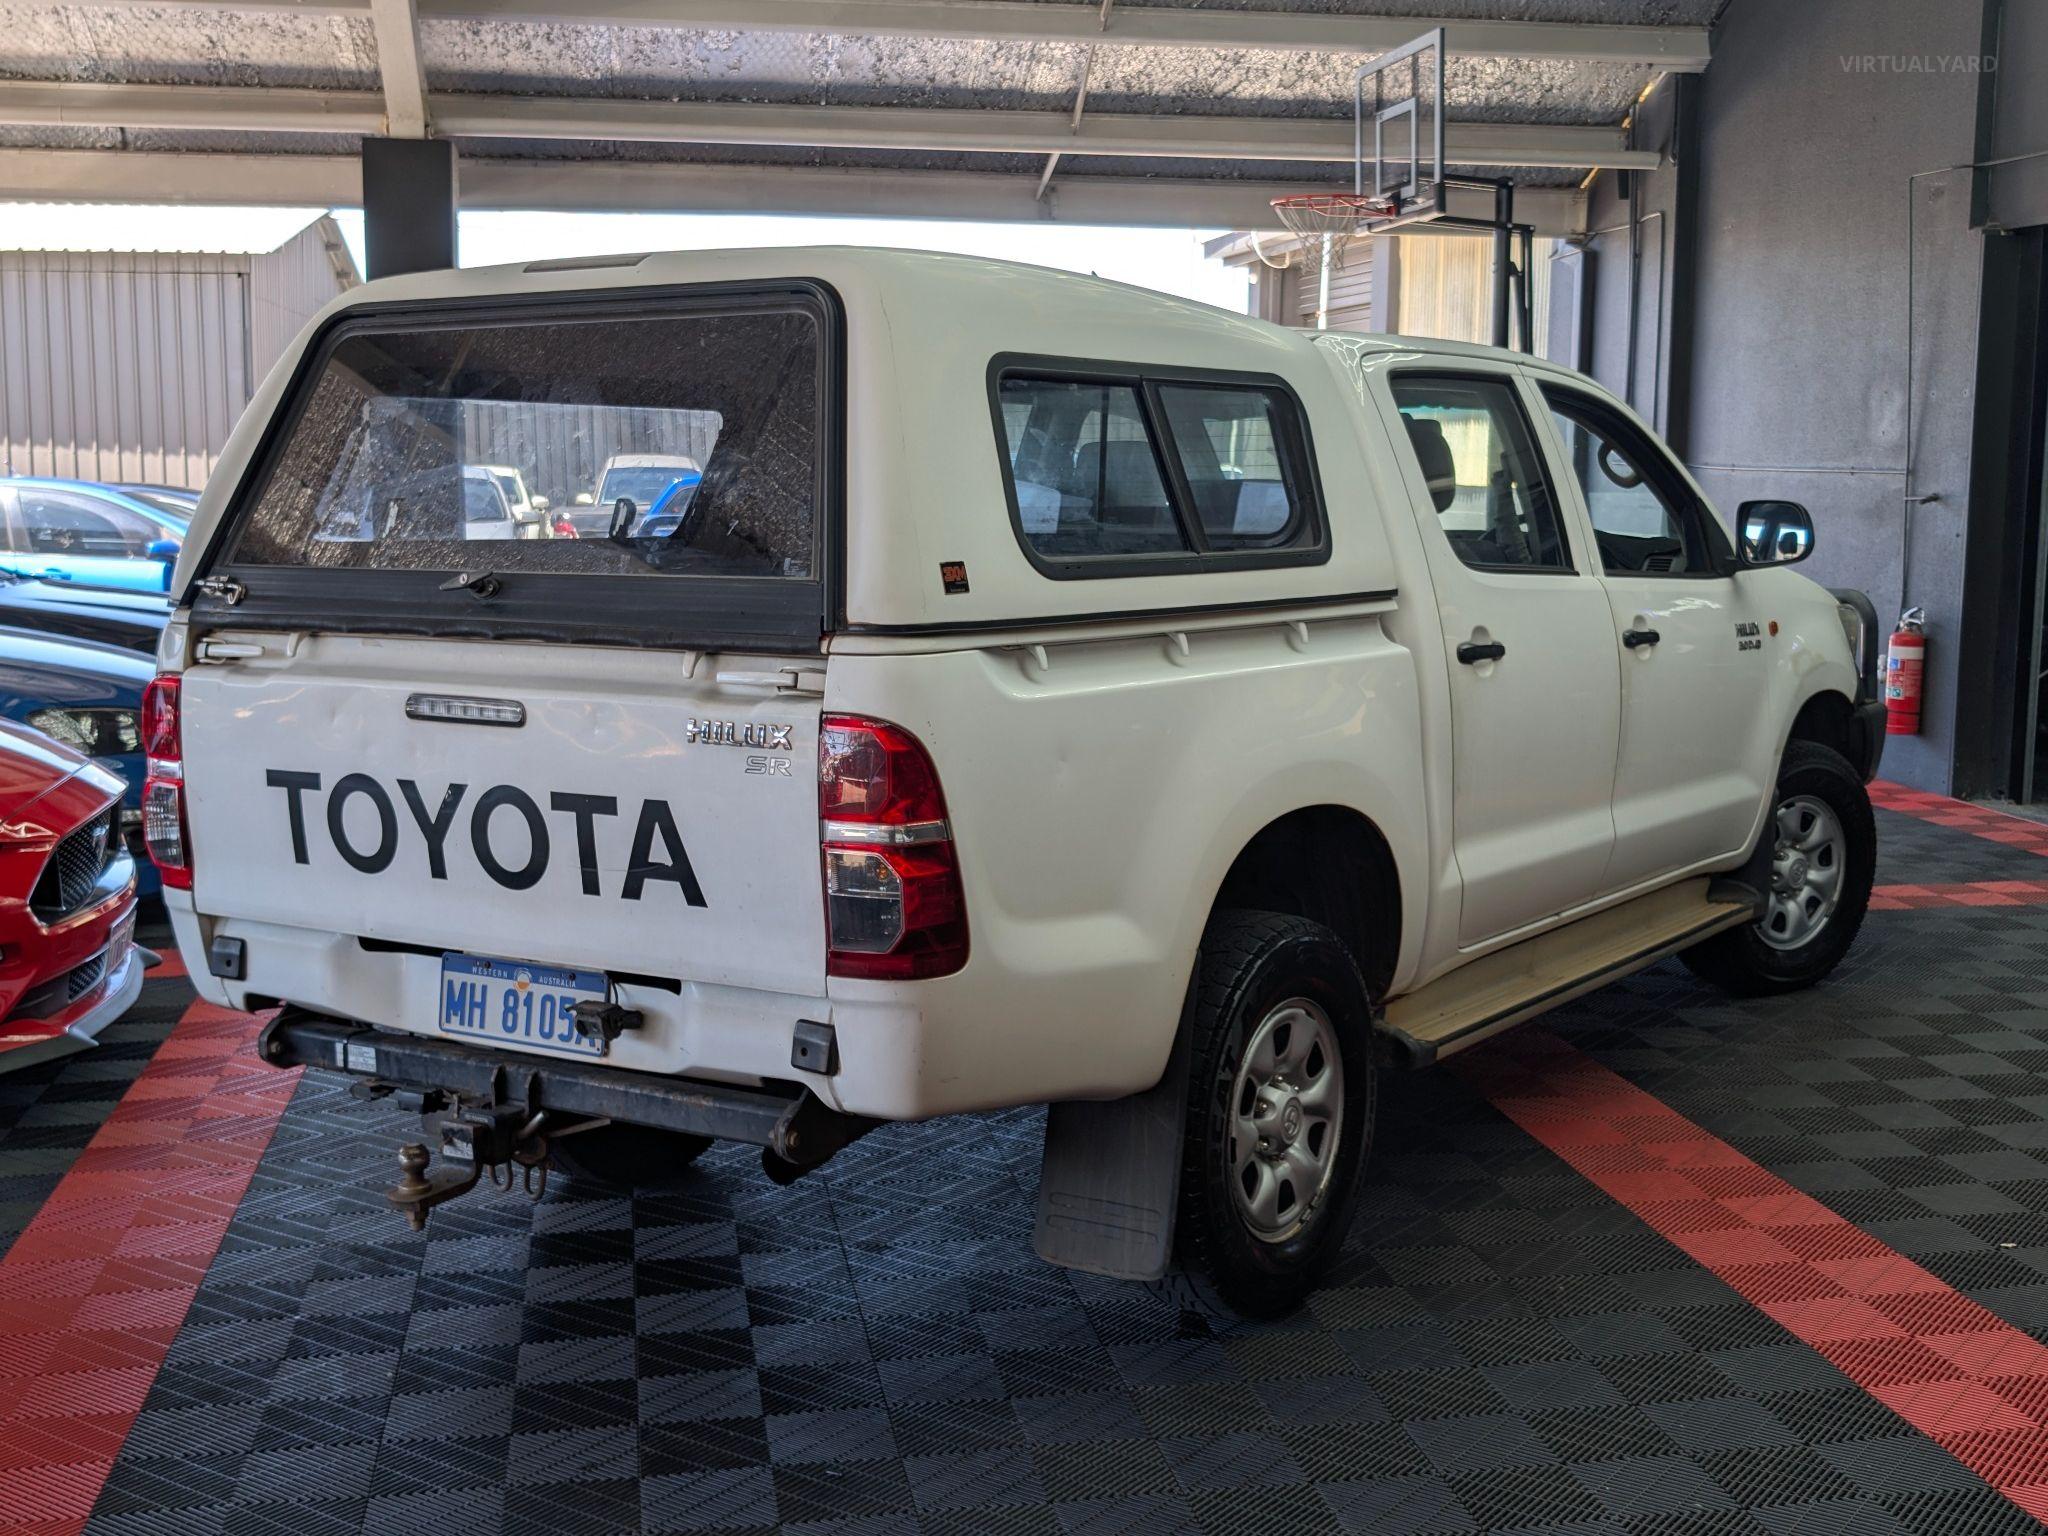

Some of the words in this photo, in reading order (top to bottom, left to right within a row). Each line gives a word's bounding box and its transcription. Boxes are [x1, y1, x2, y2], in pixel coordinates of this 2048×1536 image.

[686, 718, 792, 750] HILUX
[745, 755, 792, 776] SR
[266, 768, 709, 908] TOYOTA
[472, 966, 508, 978] WESTERN
[539, 976, 577, 988] AUSTRALIA
[445, 979, 488, 1029] MH
[502, 988, 596, 1047] 8105
